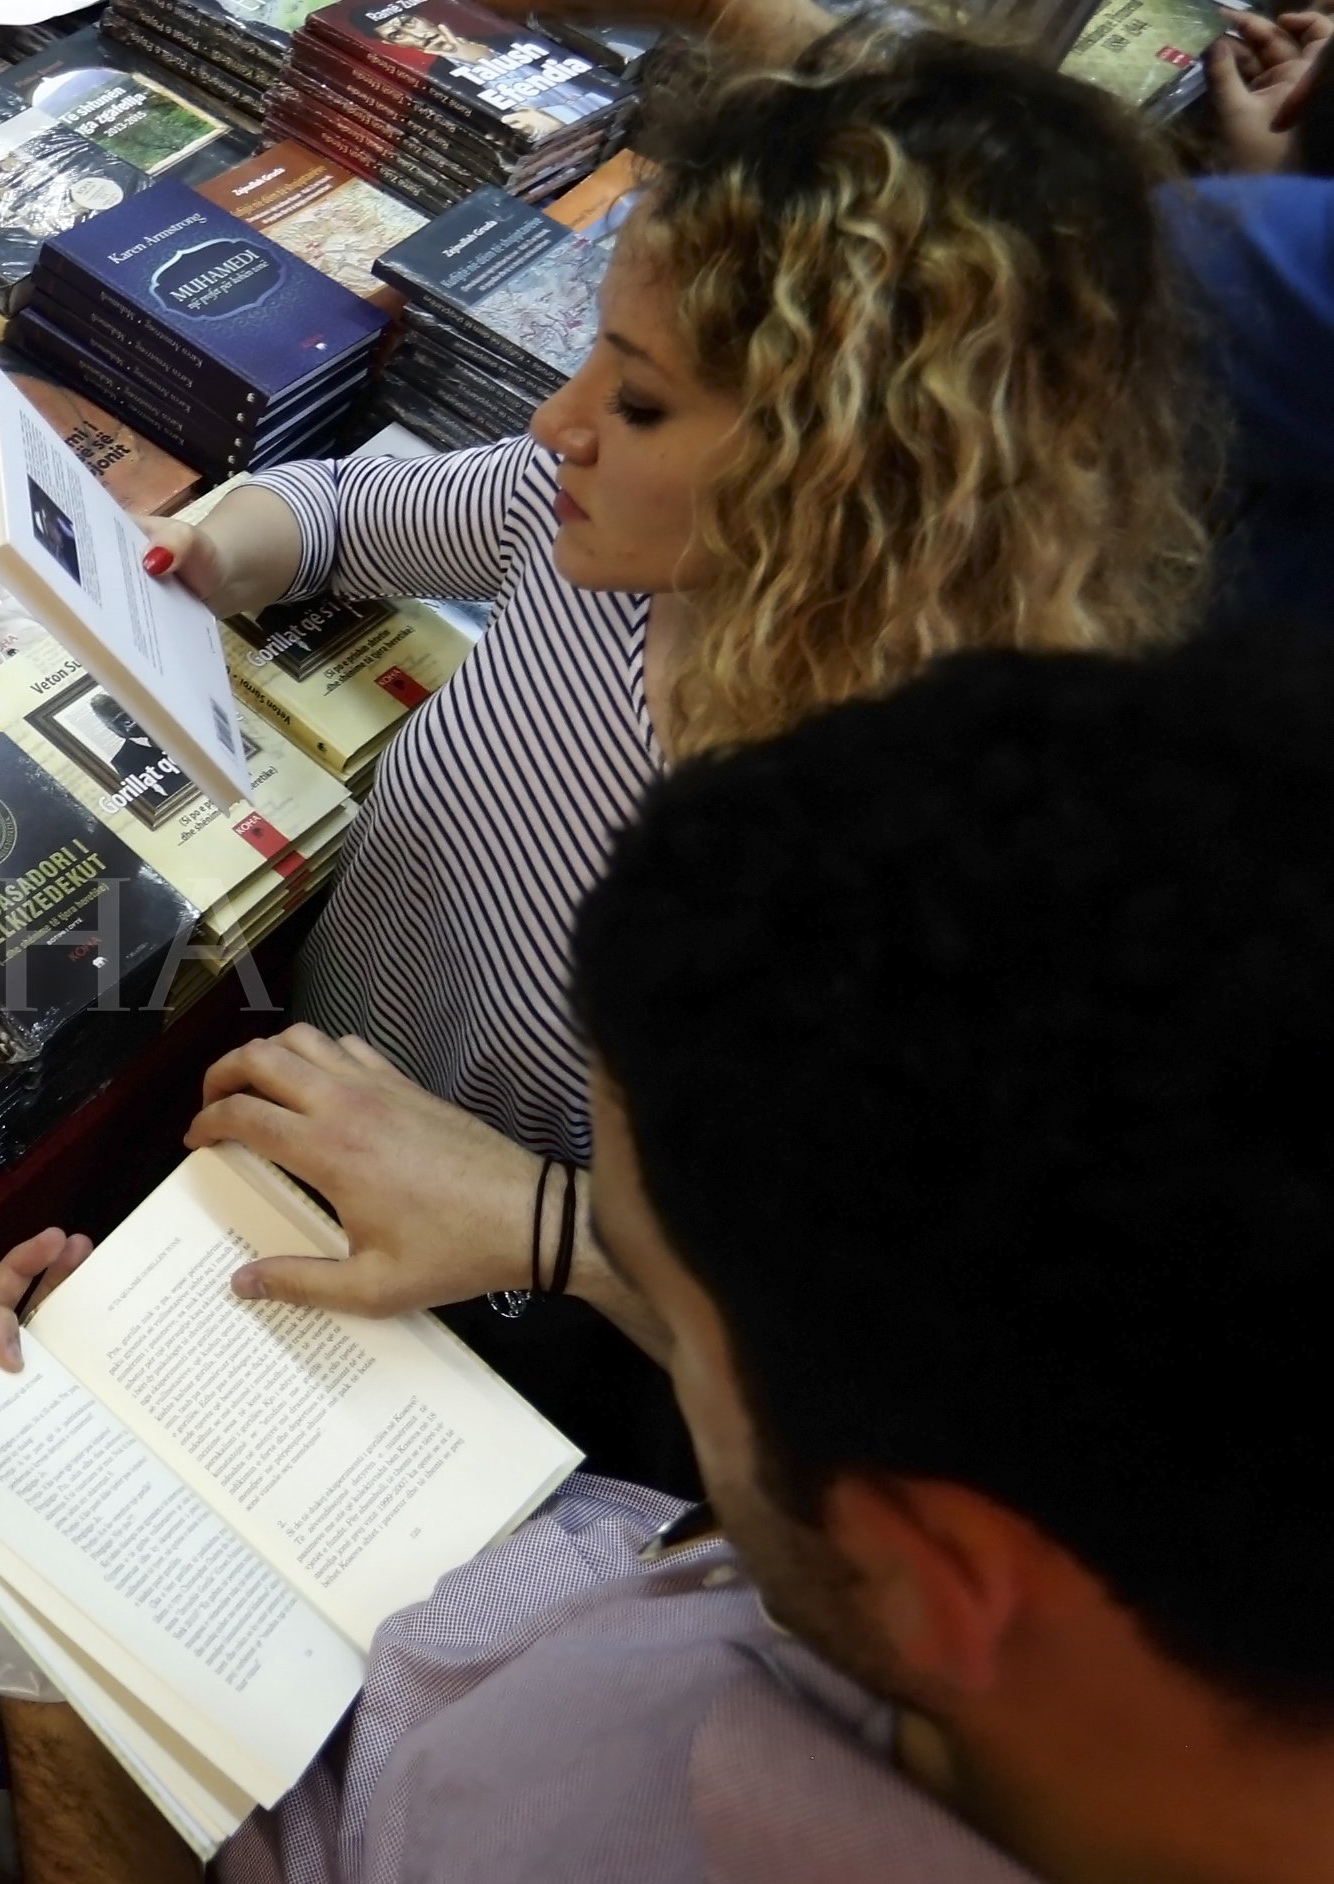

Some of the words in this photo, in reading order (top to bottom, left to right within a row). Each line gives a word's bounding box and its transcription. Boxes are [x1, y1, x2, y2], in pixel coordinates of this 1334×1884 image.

[449, 42, 550, 86] Talush
[477, 56, 594, 110] Efendia
[77, 86, 126, 116] shtunën
[103, 111, 147, 138] 2013-2015
[107, 241, 145, 265] Karen
[145, 212, 208, 247] Armstrong
[170, 249, 261, 302] MUHAMEDI
[92, 431, 114, 450] së
[246, 624, 307, 667] Gorillat
[30, 665, 69, 695] Veton
[240, 678, 265, 704] Surroi
[379, 668, 402, 686] KOHA
[267, 700, 292, 725] Veton
[99, 763, 164, 815] Gorillat
[237, 814, 262, 835] KOHA
[72, 838, 89, 854] I
[69, 936, 102, 961] KOHA
